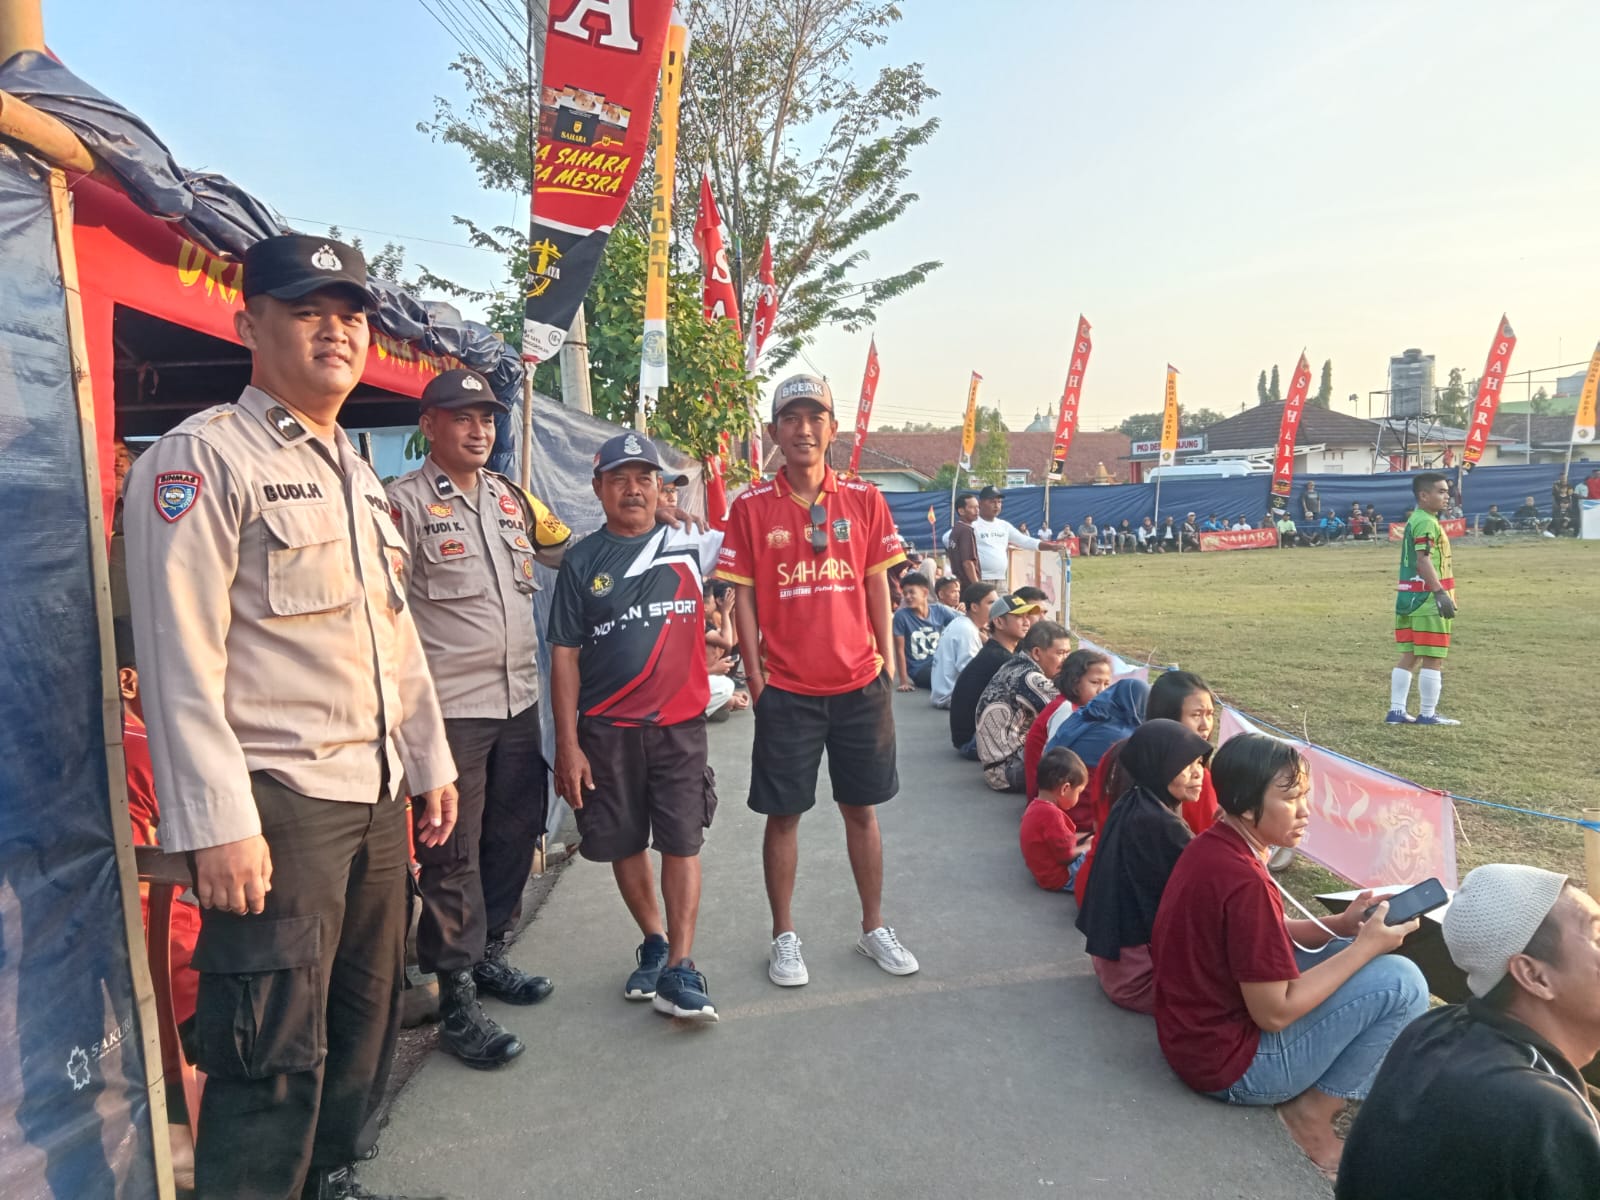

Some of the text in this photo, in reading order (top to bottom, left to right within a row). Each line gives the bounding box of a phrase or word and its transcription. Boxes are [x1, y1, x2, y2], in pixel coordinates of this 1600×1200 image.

[554, 147, 631, 174] SAHARA
[552, 168, 623, 193] MESRA
[782, 382, 824, 398] BREAK
[1059, 341, 1088, 440] SAHARA
[1471, 342, 1509, 443] SAHARA
[1136, 443, 1149, 453] PKD
[161, 474, 196, 483] BINMAS
[424, 521, 465, 535] YUDI K.
[1221, 531, 1275, 544] SAHARA
[776, 557, 856, 587] SAHARA
[648, 600, 696, 617] SPORT
